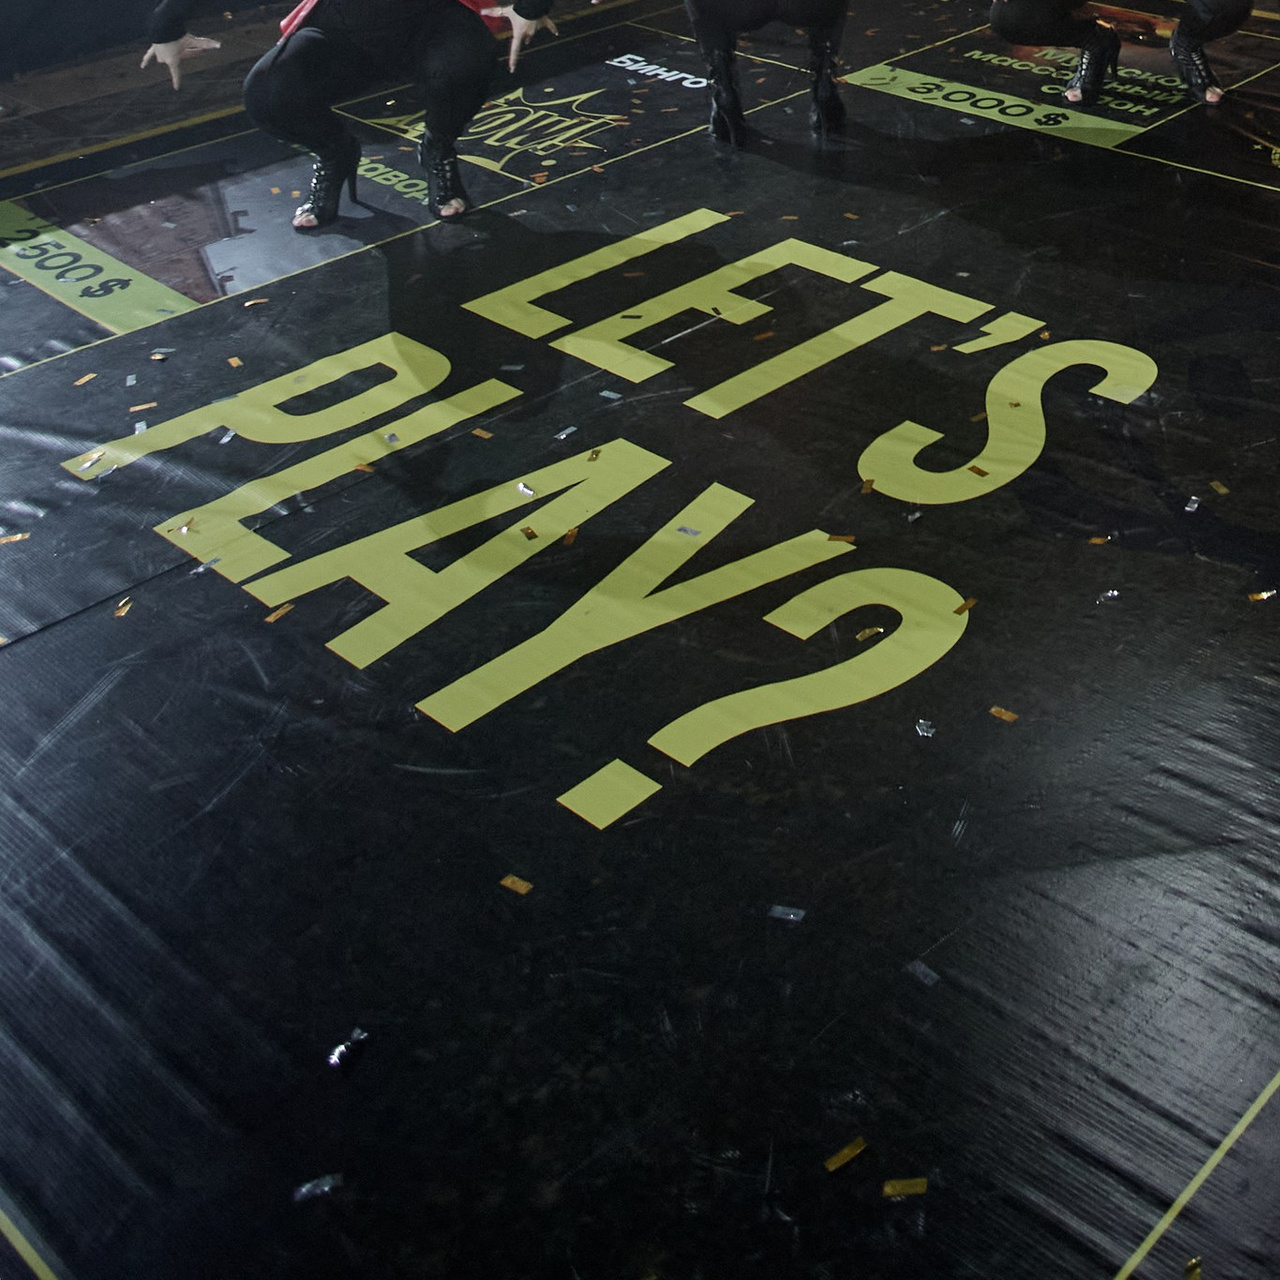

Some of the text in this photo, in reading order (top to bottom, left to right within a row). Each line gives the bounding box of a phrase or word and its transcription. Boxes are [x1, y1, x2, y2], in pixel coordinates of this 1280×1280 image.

[604, 53, 709, 89] Бинго
[907, 82, 1071, 128] 3000 $
[79, 278, 133, 298] $
[60, 331, 972, 830] PLAY?
